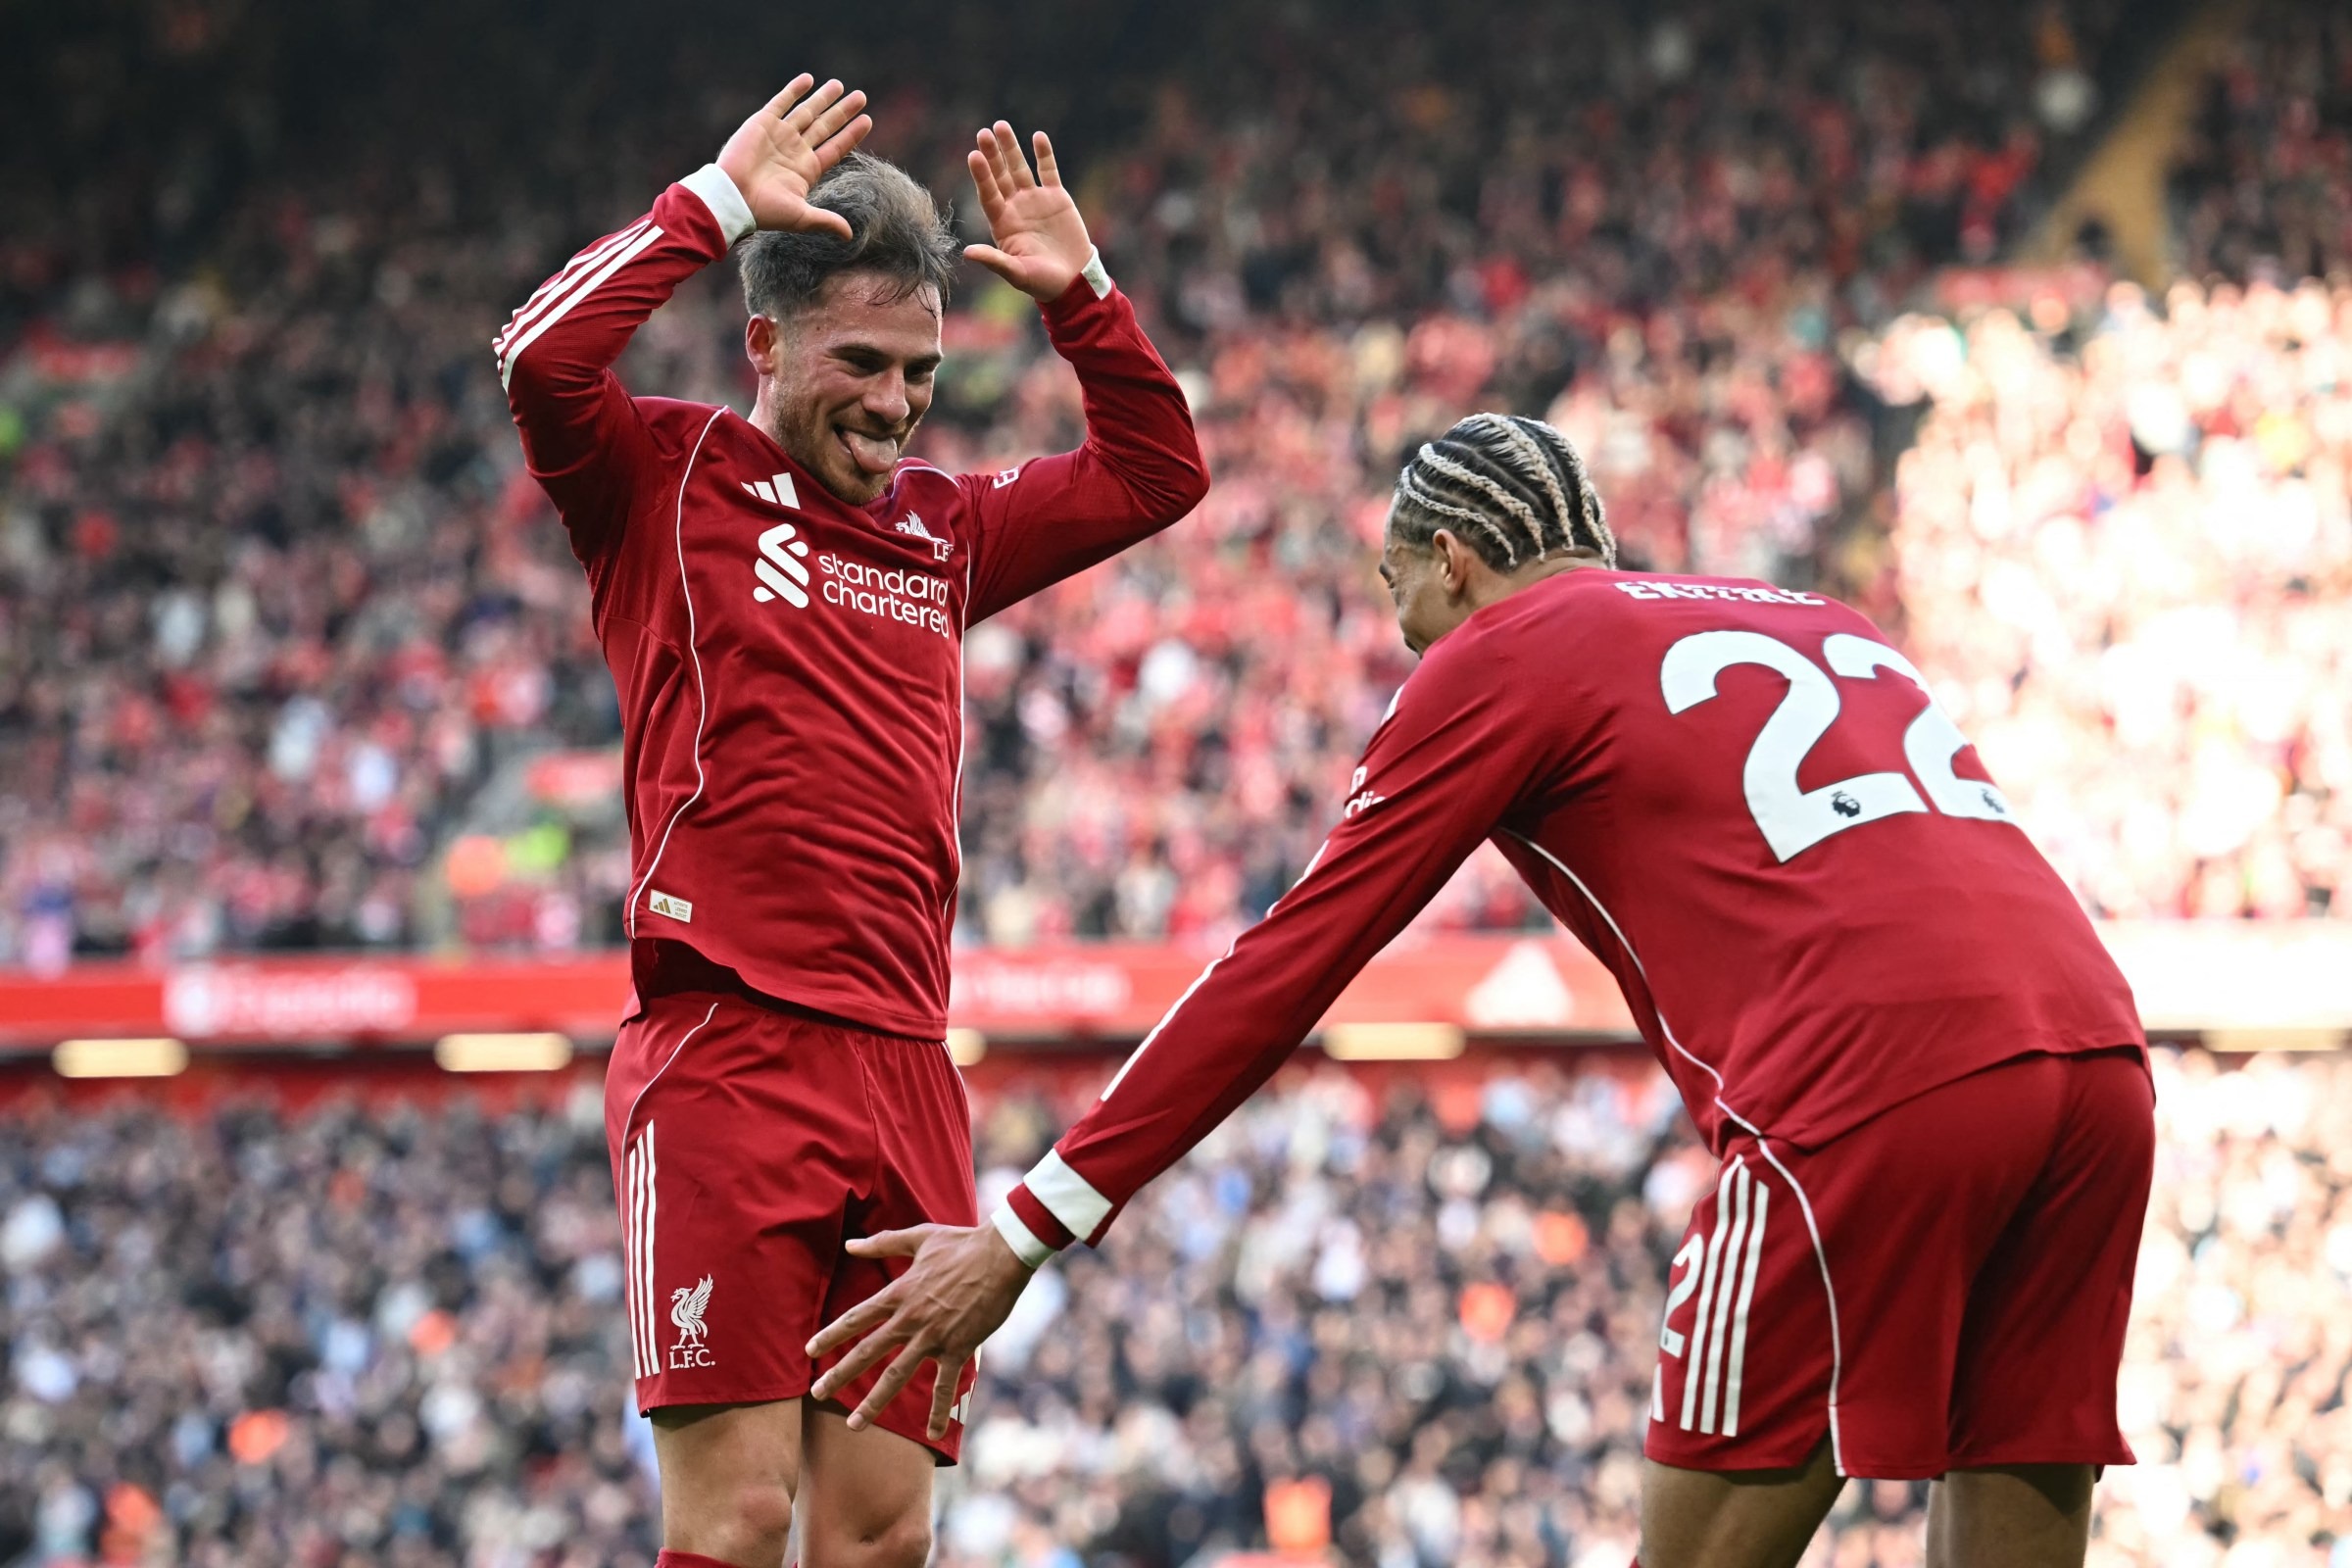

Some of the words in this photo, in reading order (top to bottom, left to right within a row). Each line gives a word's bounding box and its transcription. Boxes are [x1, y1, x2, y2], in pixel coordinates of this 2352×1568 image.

[818, 553, 949, 608] standard
[823, 578, 950, 640] chartered
[1659, 630, 2023, 864] 22
[668, 1348, 716, 1370] L.F.C.
